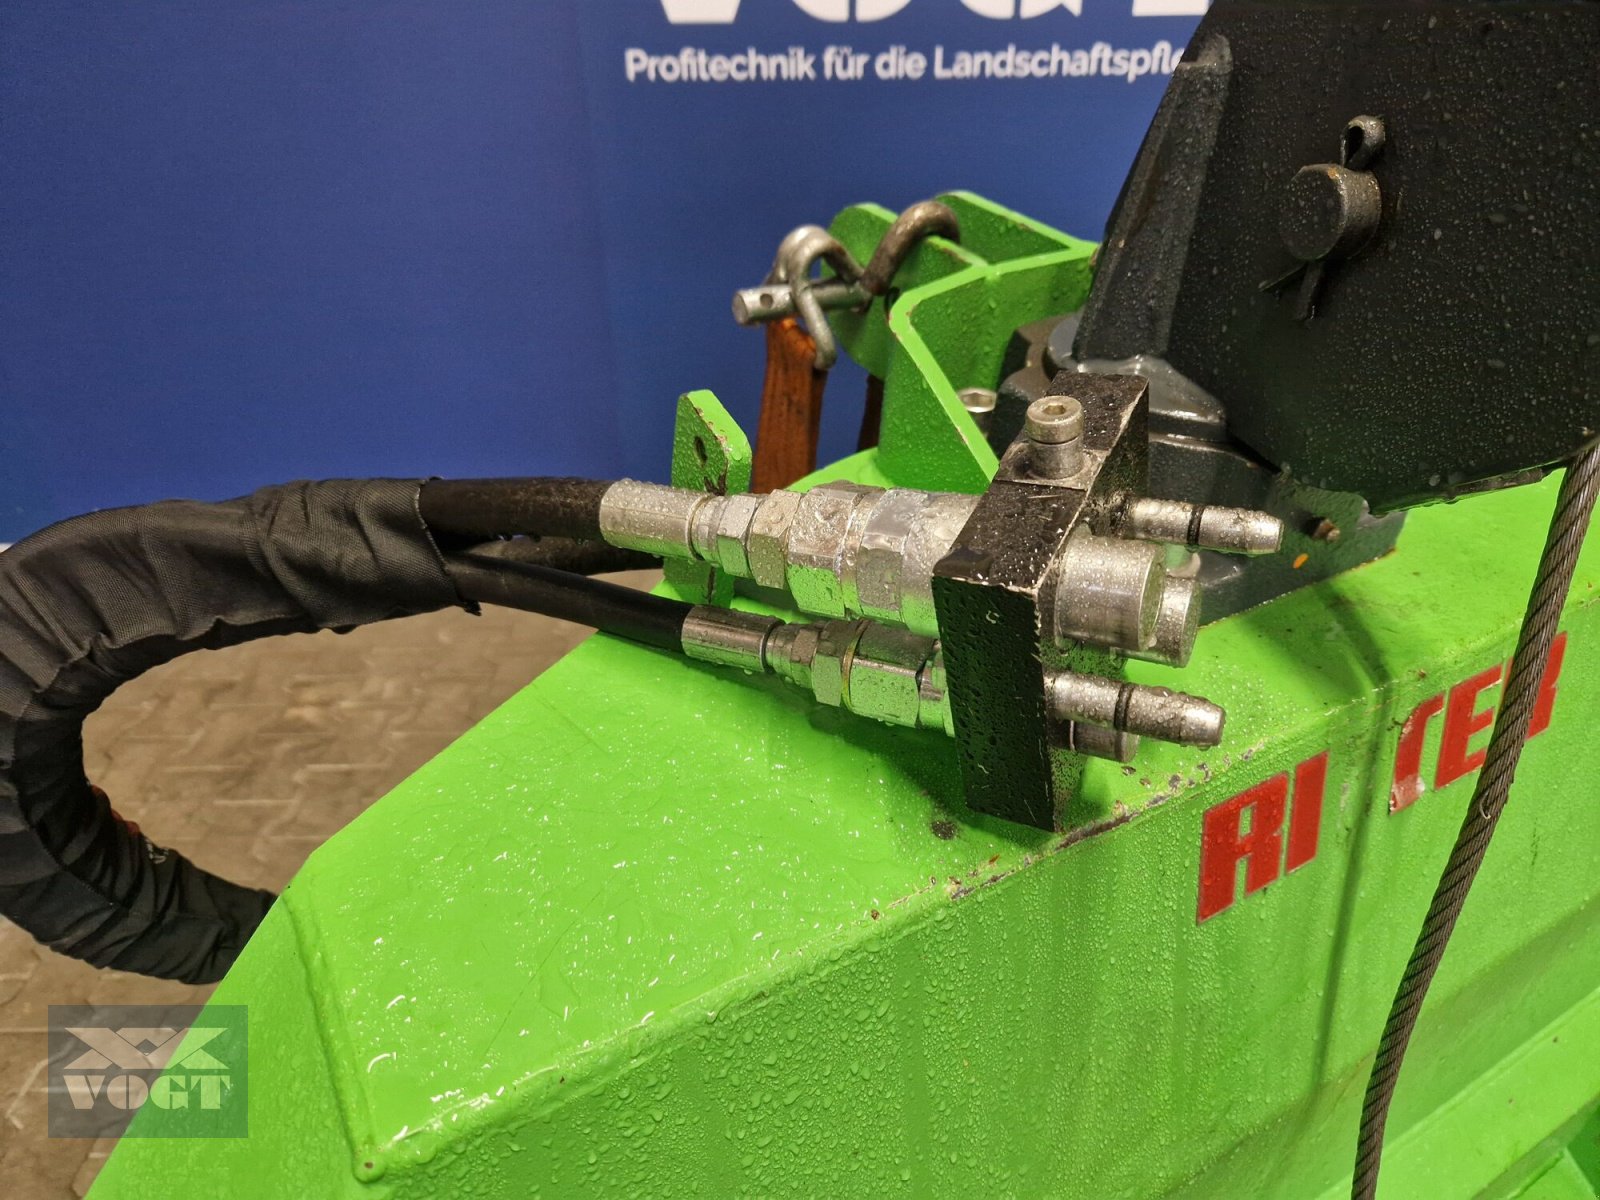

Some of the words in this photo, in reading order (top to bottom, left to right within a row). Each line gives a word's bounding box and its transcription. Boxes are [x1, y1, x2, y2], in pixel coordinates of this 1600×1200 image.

[624, 46, 816, 83] Profitechnik
[822, 45, 870, 81] für
[874, 44, 928, 81] die
